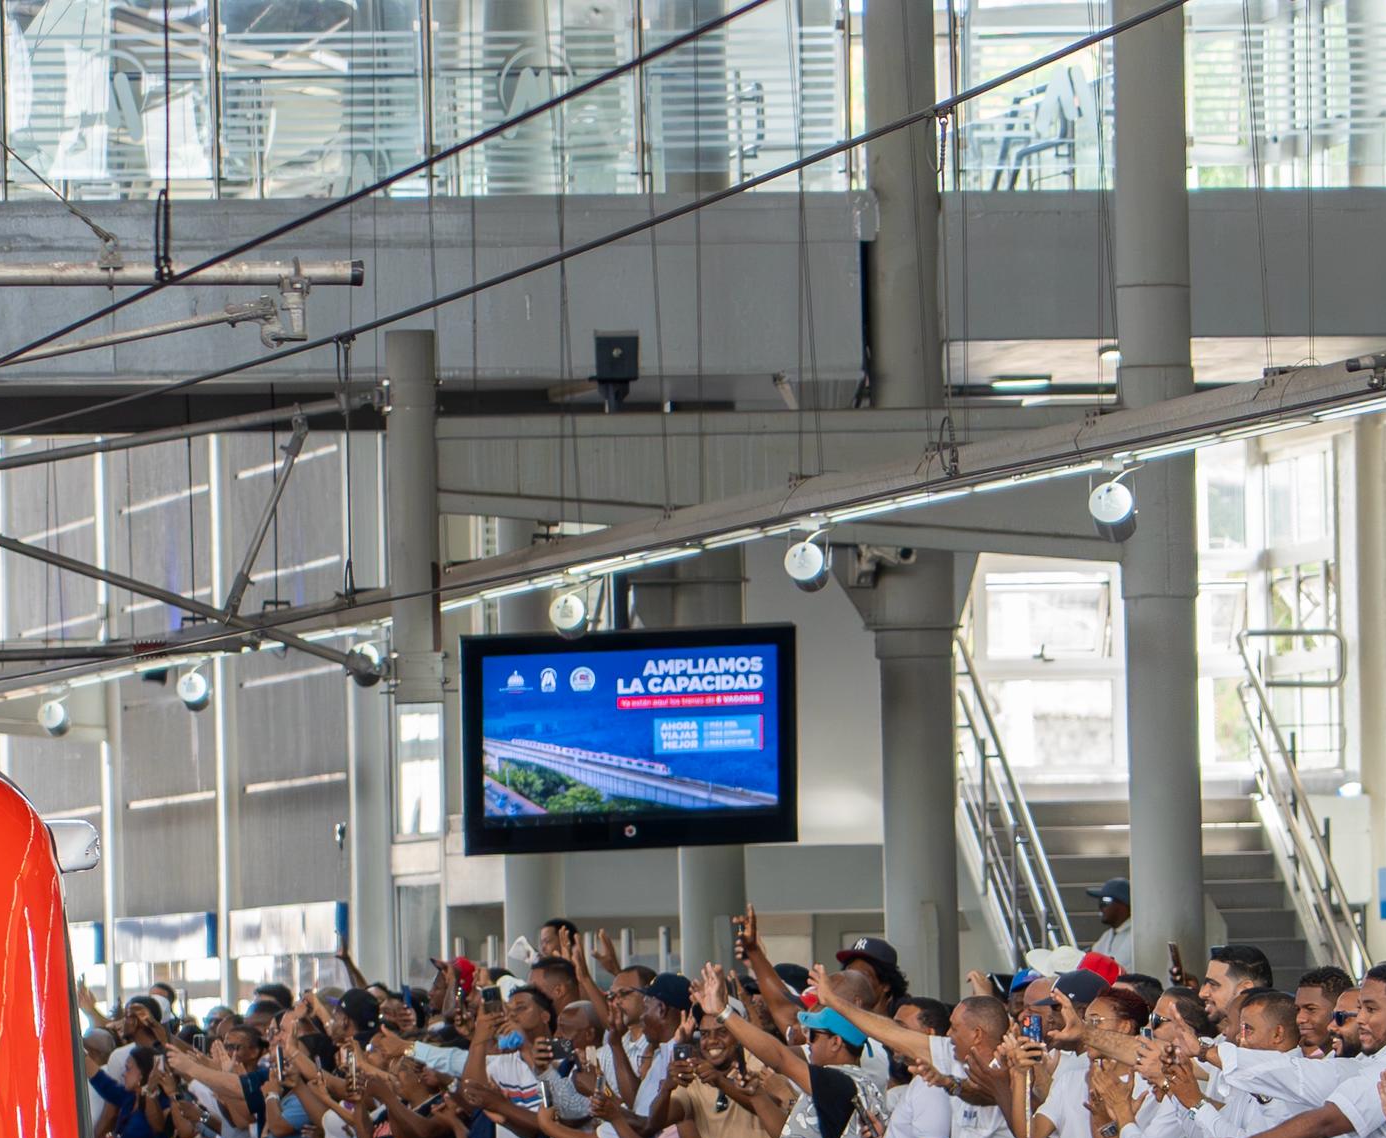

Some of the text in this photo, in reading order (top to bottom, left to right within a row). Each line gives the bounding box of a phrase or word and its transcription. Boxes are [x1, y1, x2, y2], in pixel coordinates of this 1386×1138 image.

[643, 656, 763, 676] AMPLIAMOS
[617, 673, 763, 694] LA CAPACIDAD
[661, 721, 698, 731] AHORA
[661, 730, 698, 740] VIAJAS
[663, 739, 698, 750] MEJOR
